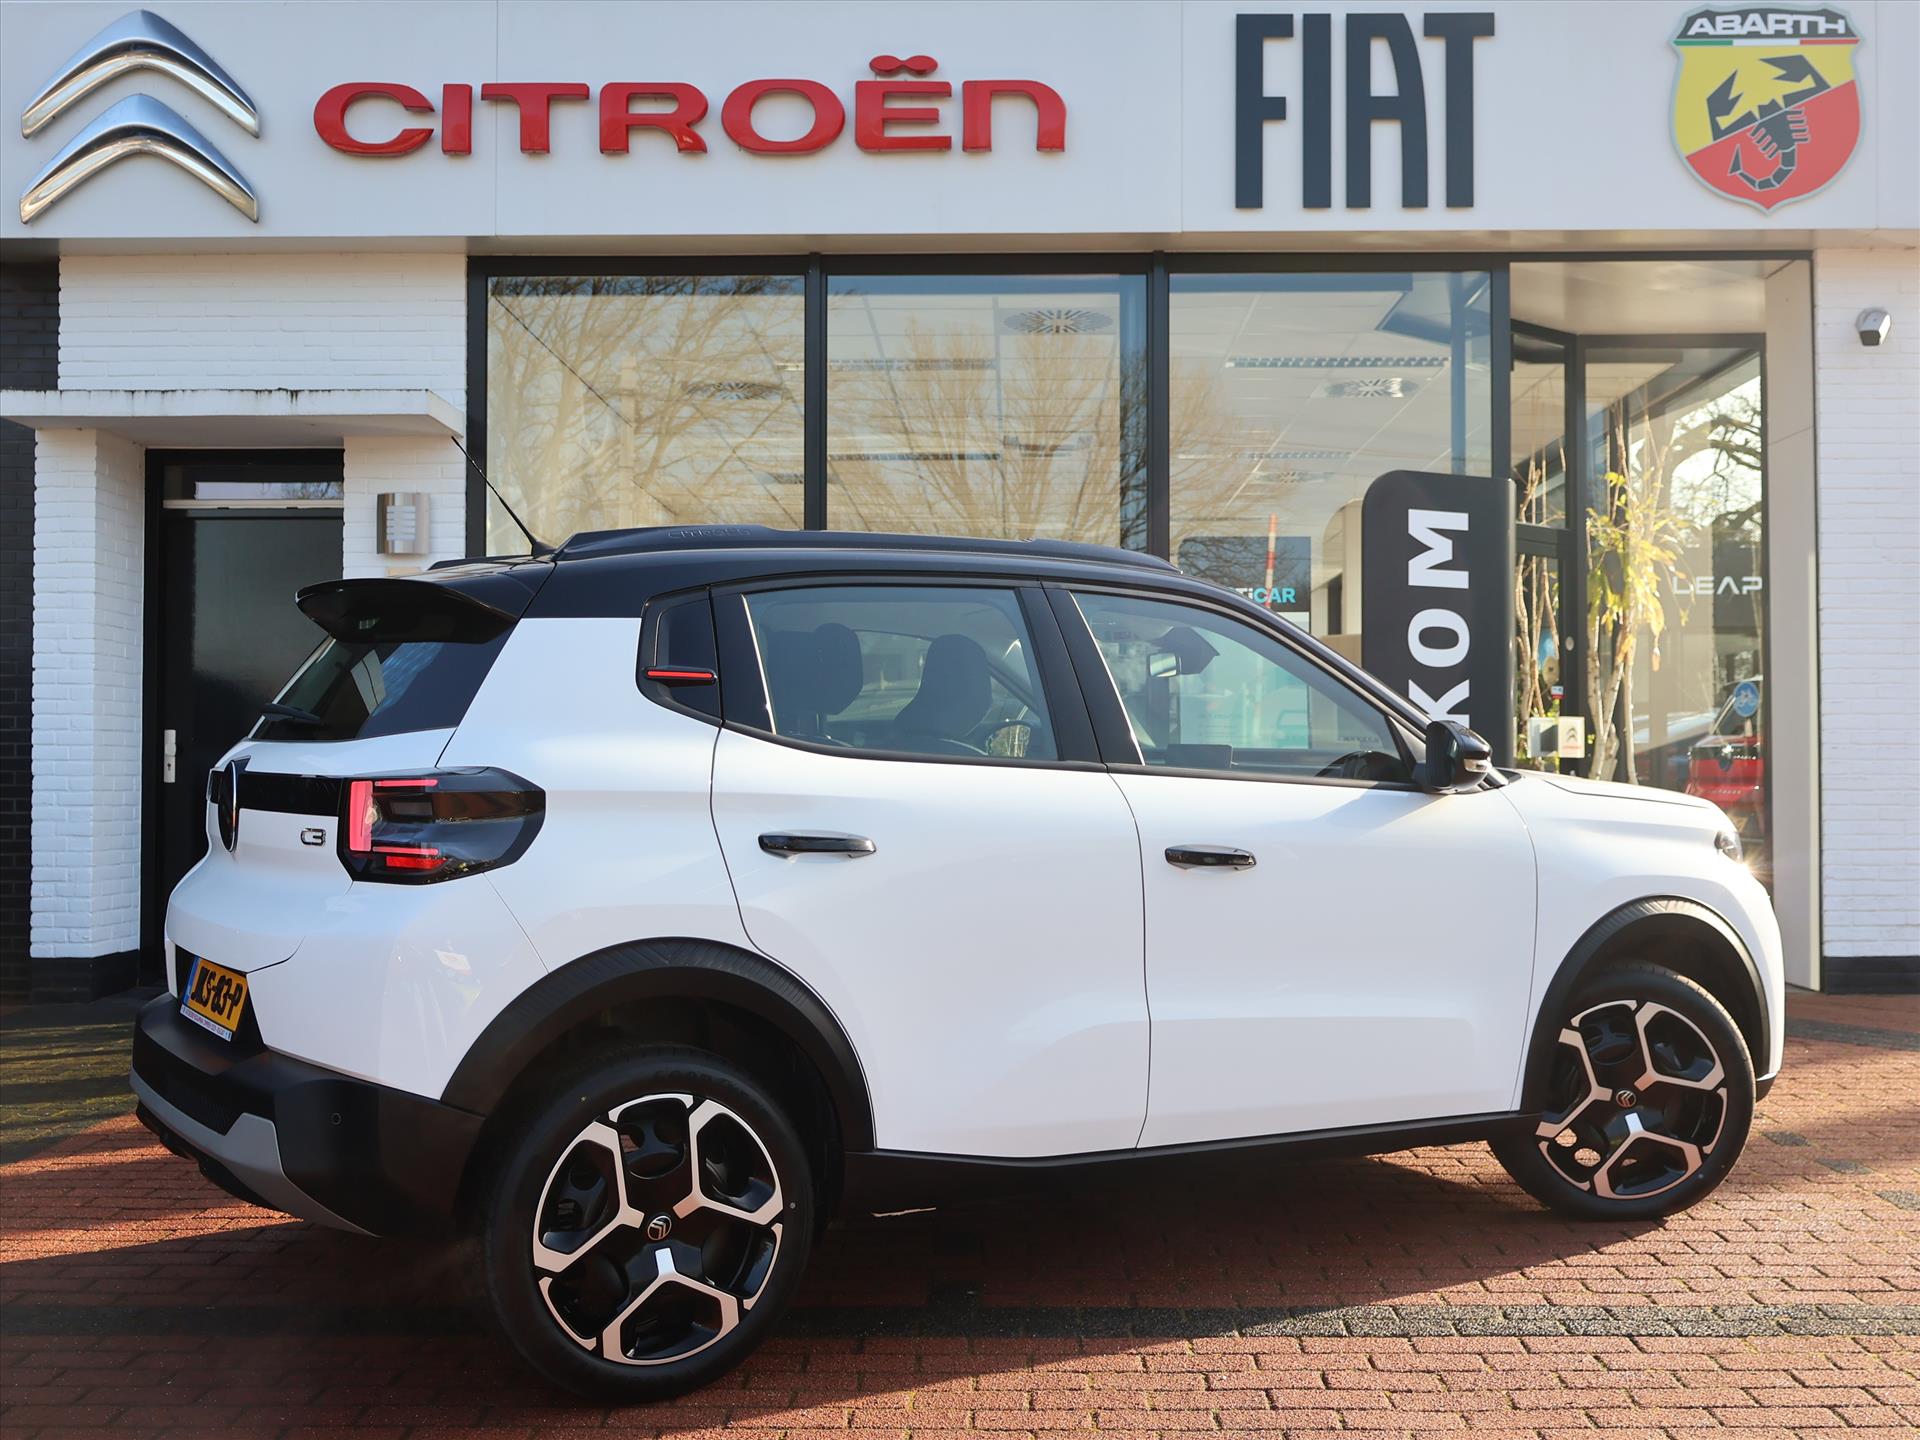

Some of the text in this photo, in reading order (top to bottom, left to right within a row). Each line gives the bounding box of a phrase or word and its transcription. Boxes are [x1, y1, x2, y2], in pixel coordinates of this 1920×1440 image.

[1686, 13, 1846, 36] ABARTH
[314, 55, 1067, 156] CITROËN
[1235, 13, 1495, 208] FIAT
[1230, 587, 1297, 603] TiCAR
[1672, 576, 1763, 595] LEAP
[300, 827, 327, 847] C3
